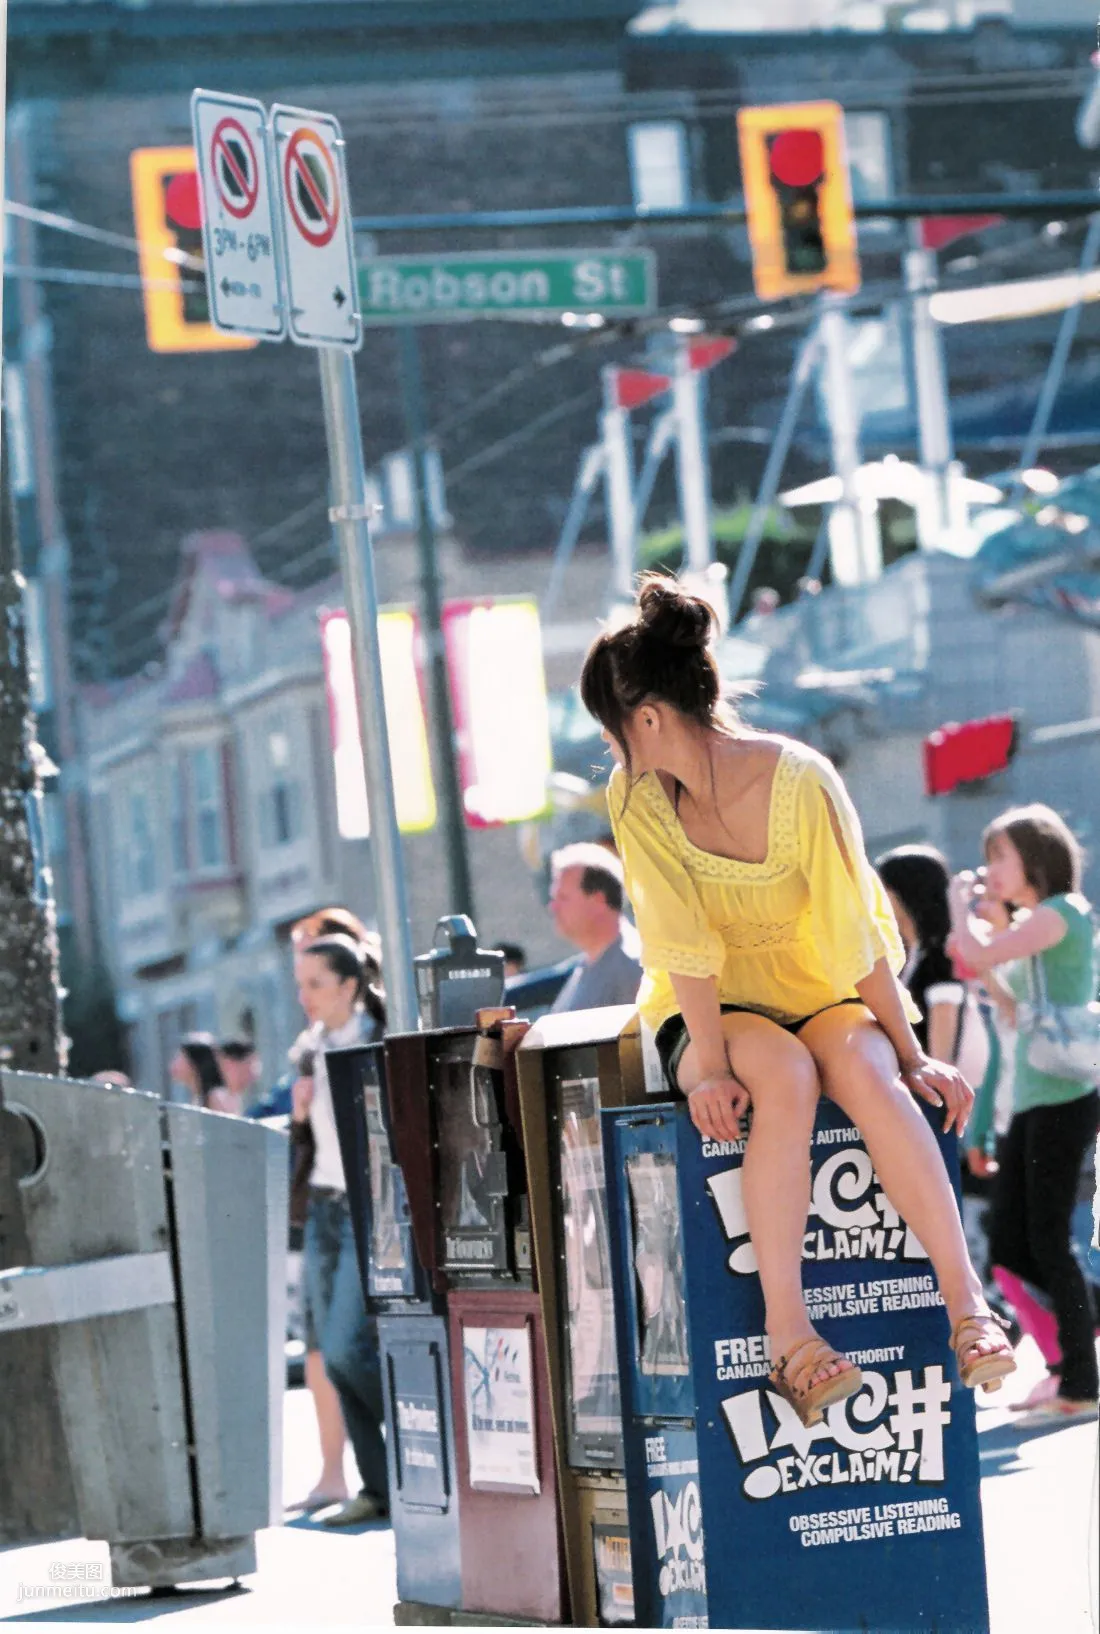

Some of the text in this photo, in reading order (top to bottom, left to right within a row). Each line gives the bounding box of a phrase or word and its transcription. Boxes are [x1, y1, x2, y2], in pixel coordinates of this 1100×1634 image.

[368, 259, 627, 309] Robson St
[702, 1139, 748, 1158] CANAD
[816, 1127, 862, 1145] AUTHO
[801, 1227, 904, 1261] CLAiM!
[803, 1275, 934, 1304] ESSIVE LISTENING
[805, 1291, 946, 1320] MPULSIVE READING
[716, 1345, 905, 1381] CANADA THORITY
[789, 1498, 949, 1532] OBSESSIVE LISTENING
[801, 1513, 961, 1547] COMPULSIVE READING
